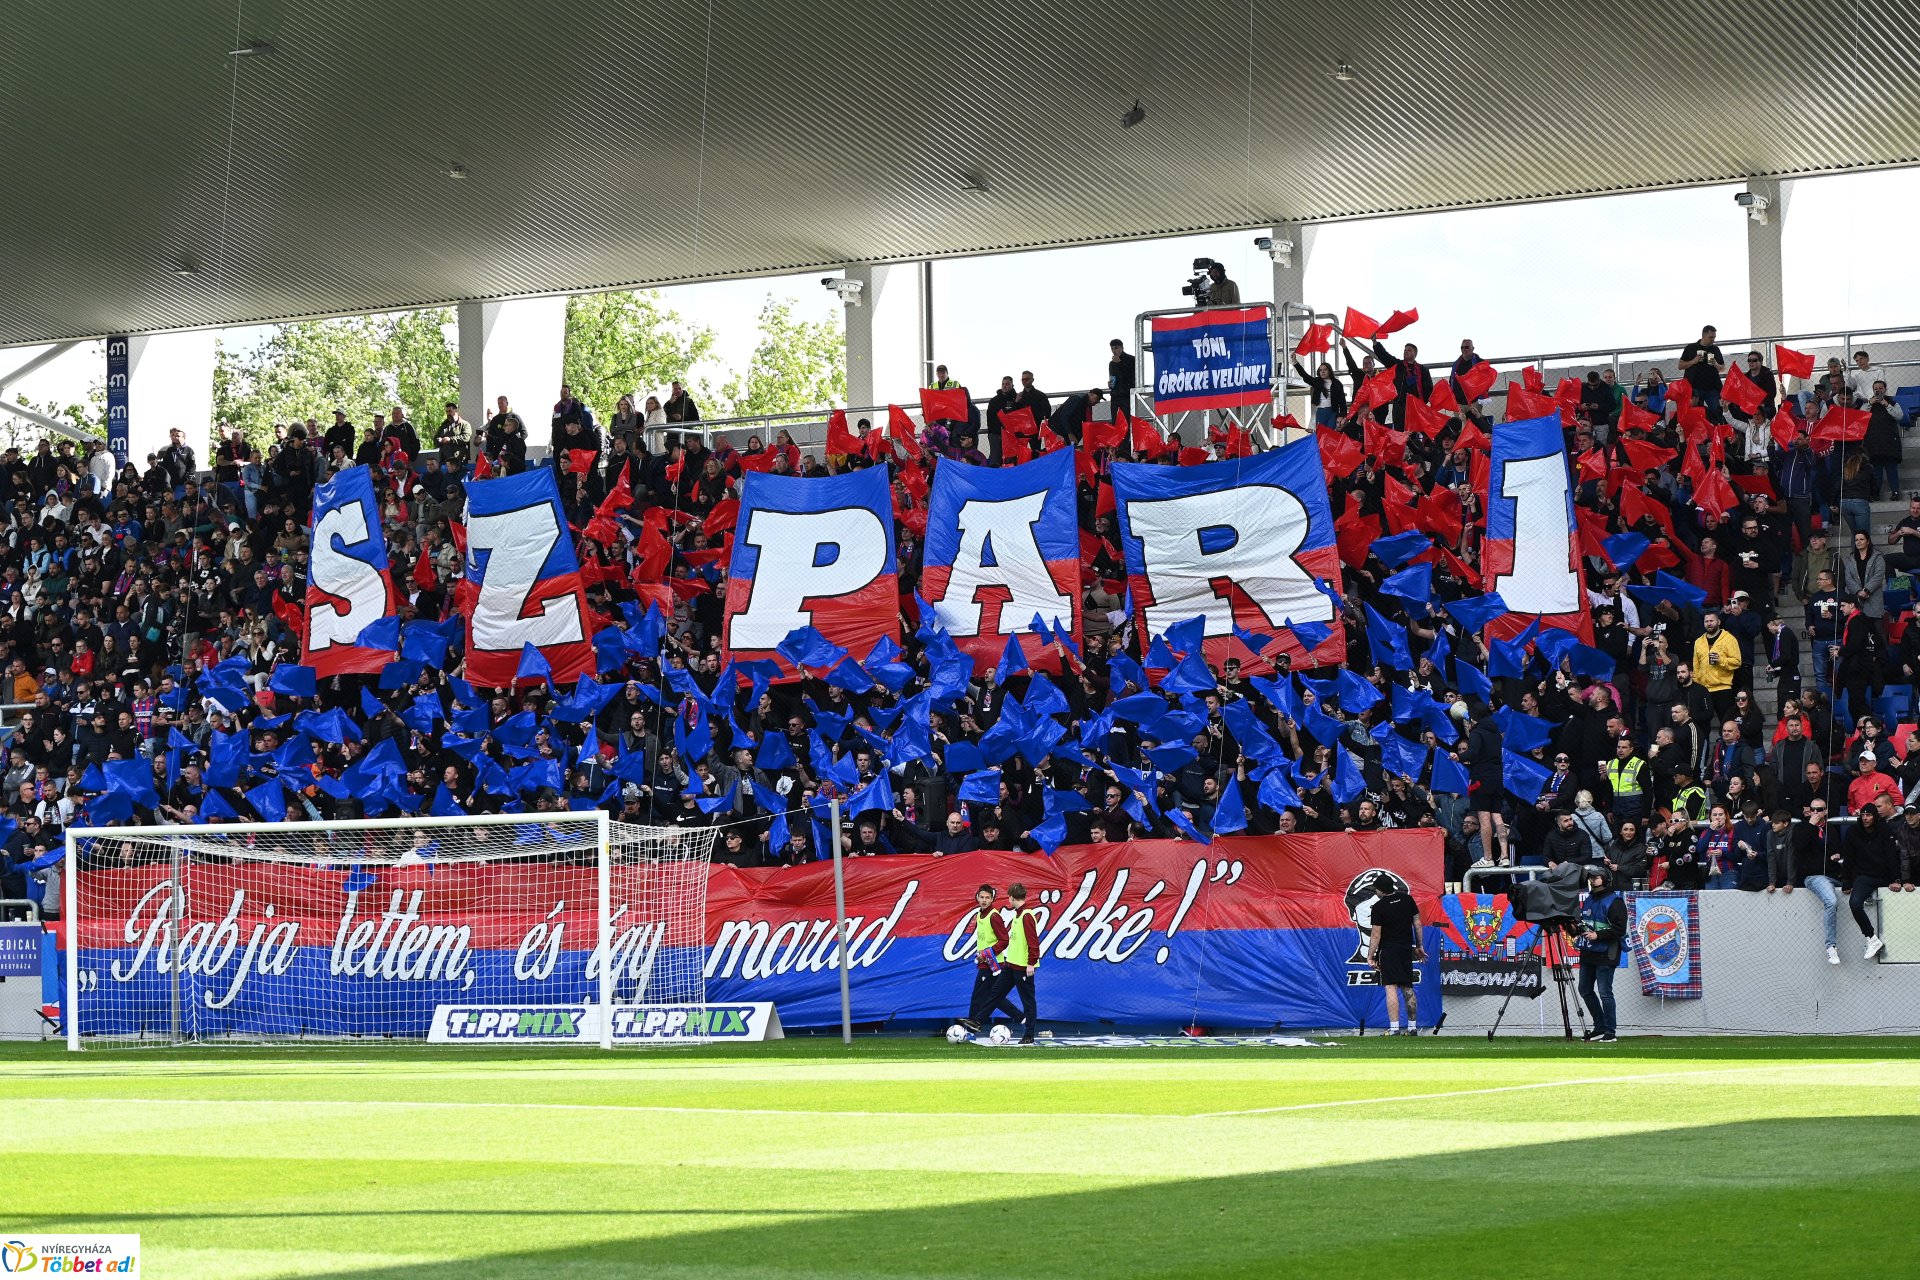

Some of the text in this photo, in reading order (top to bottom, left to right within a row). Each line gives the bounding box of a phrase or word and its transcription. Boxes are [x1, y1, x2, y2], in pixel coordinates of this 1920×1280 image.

[1192, 332, 1231, 360] TÓNI,
[1158, 361, 1267, 395] ÖRÖKKÉ VELÜNK!
[331, 888, 475, 992] lettem,
[514, 899, 565, 981] és
[705, 880, 919, 981] marad
